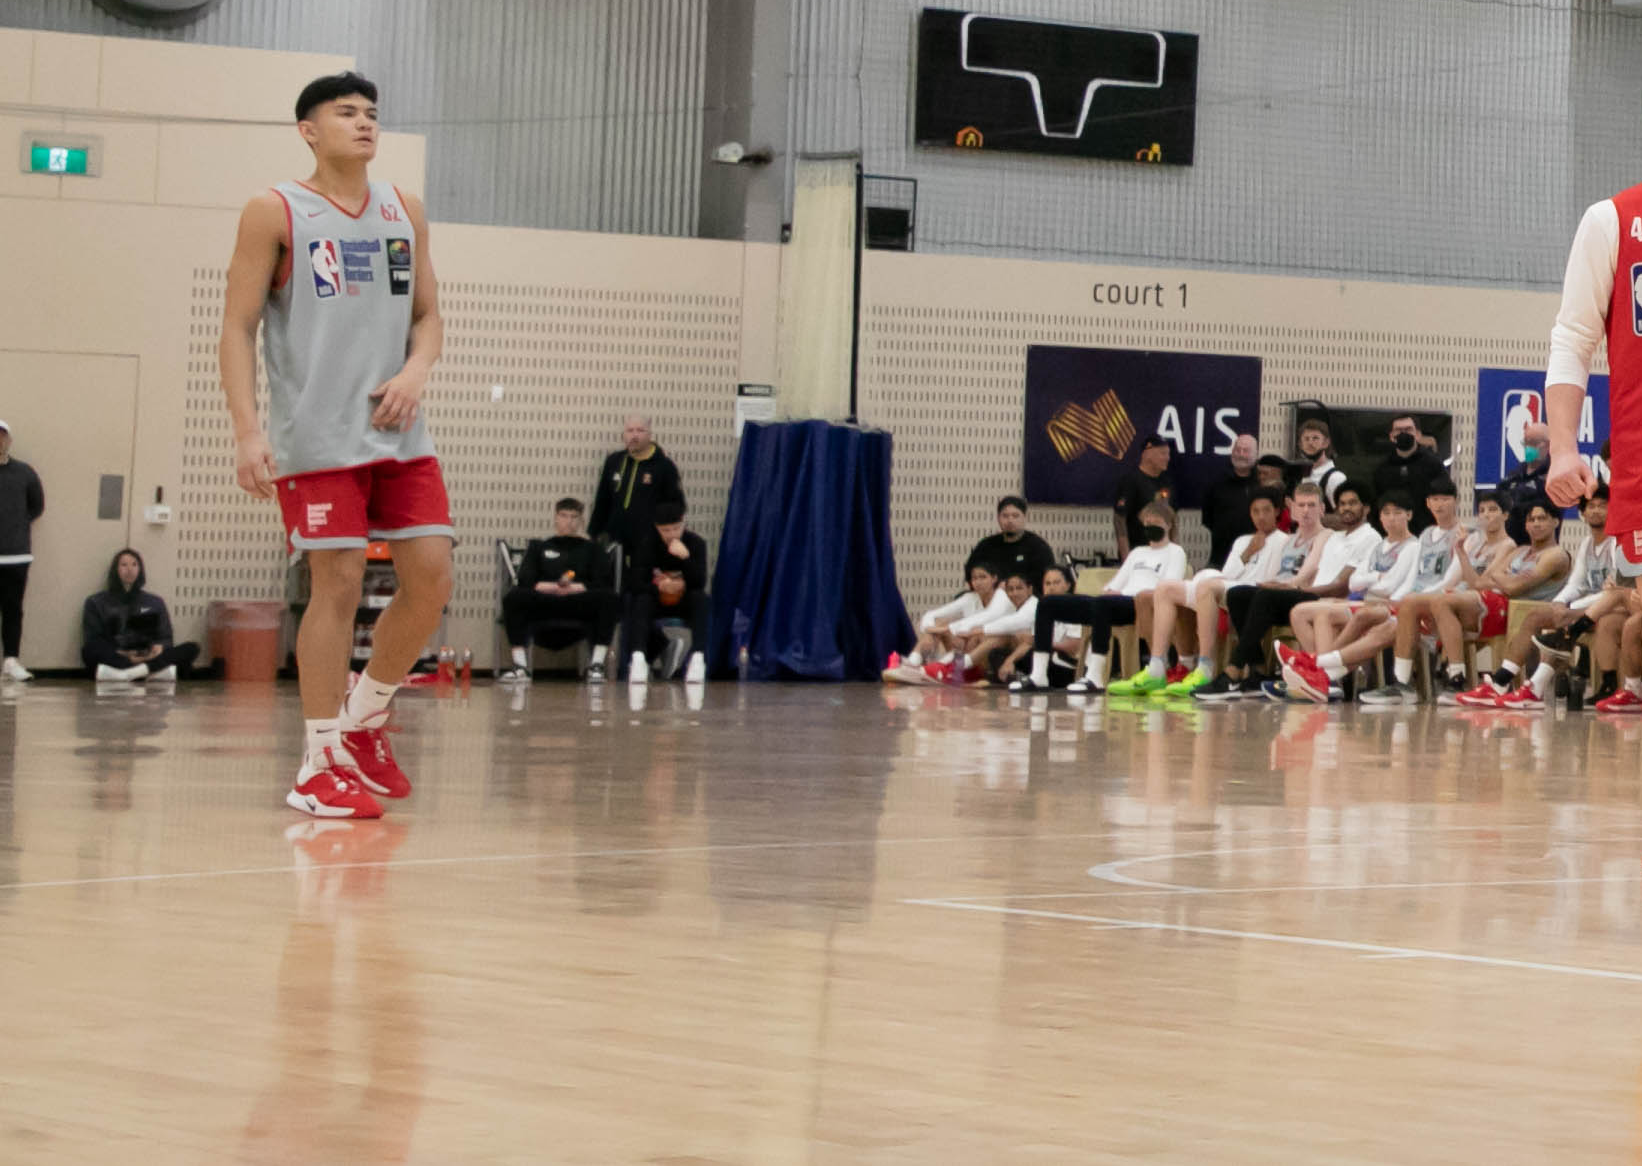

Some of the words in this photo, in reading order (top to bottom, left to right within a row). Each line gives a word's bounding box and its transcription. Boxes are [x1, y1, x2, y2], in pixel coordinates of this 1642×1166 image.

[1093, 283, 1164, 307] court
[1178, 283, 1188, 308] 1
[1157, 404, 1240, 456] AIS
